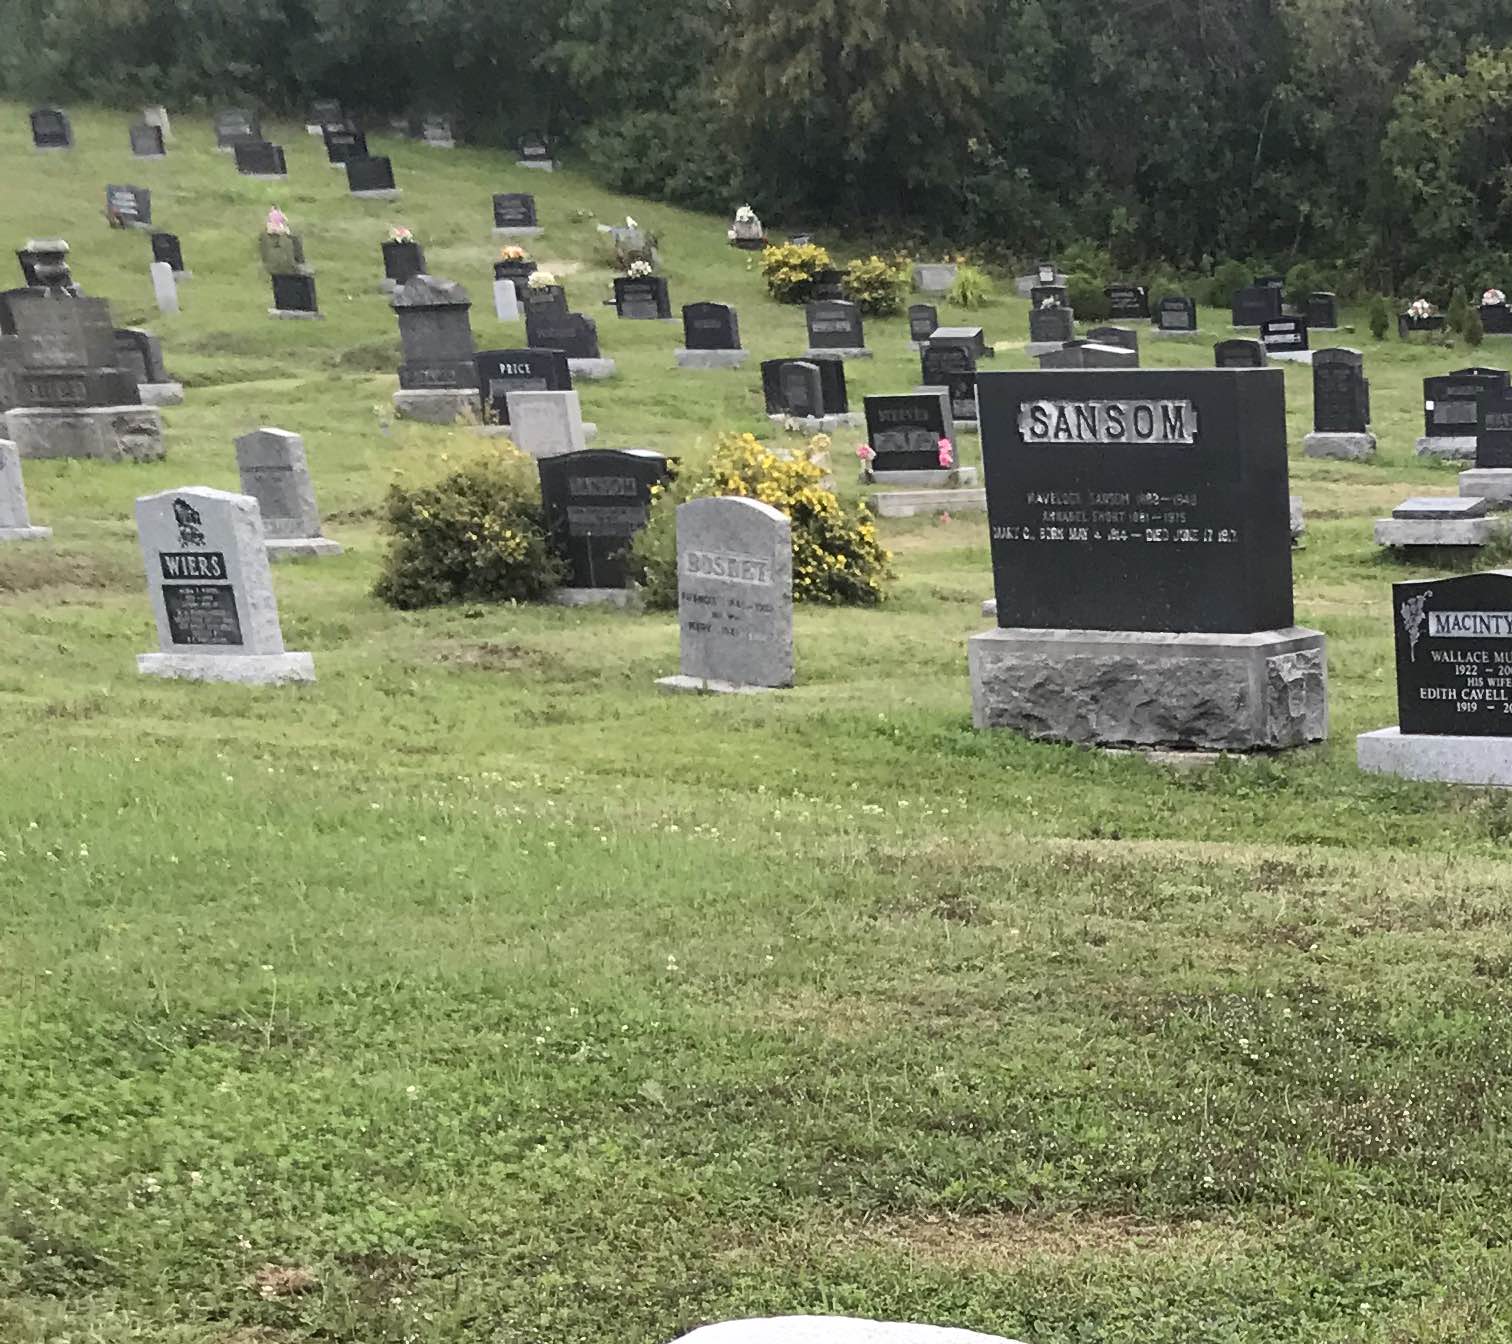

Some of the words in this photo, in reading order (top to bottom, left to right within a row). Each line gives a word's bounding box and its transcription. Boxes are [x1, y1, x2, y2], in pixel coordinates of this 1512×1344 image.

[499, 363, 531, 374] PRICE
[1030, 404, 1187, 440] SANSOM
[165, 556, 221, 576] WIERS
[1431, 651, 1489, 662] WALLACE
[1488, 677, 1512, 687] WIFE
[1420, 688, 1457, 700] EDITH
[1461, 689, 1508, 701] CAVELL
